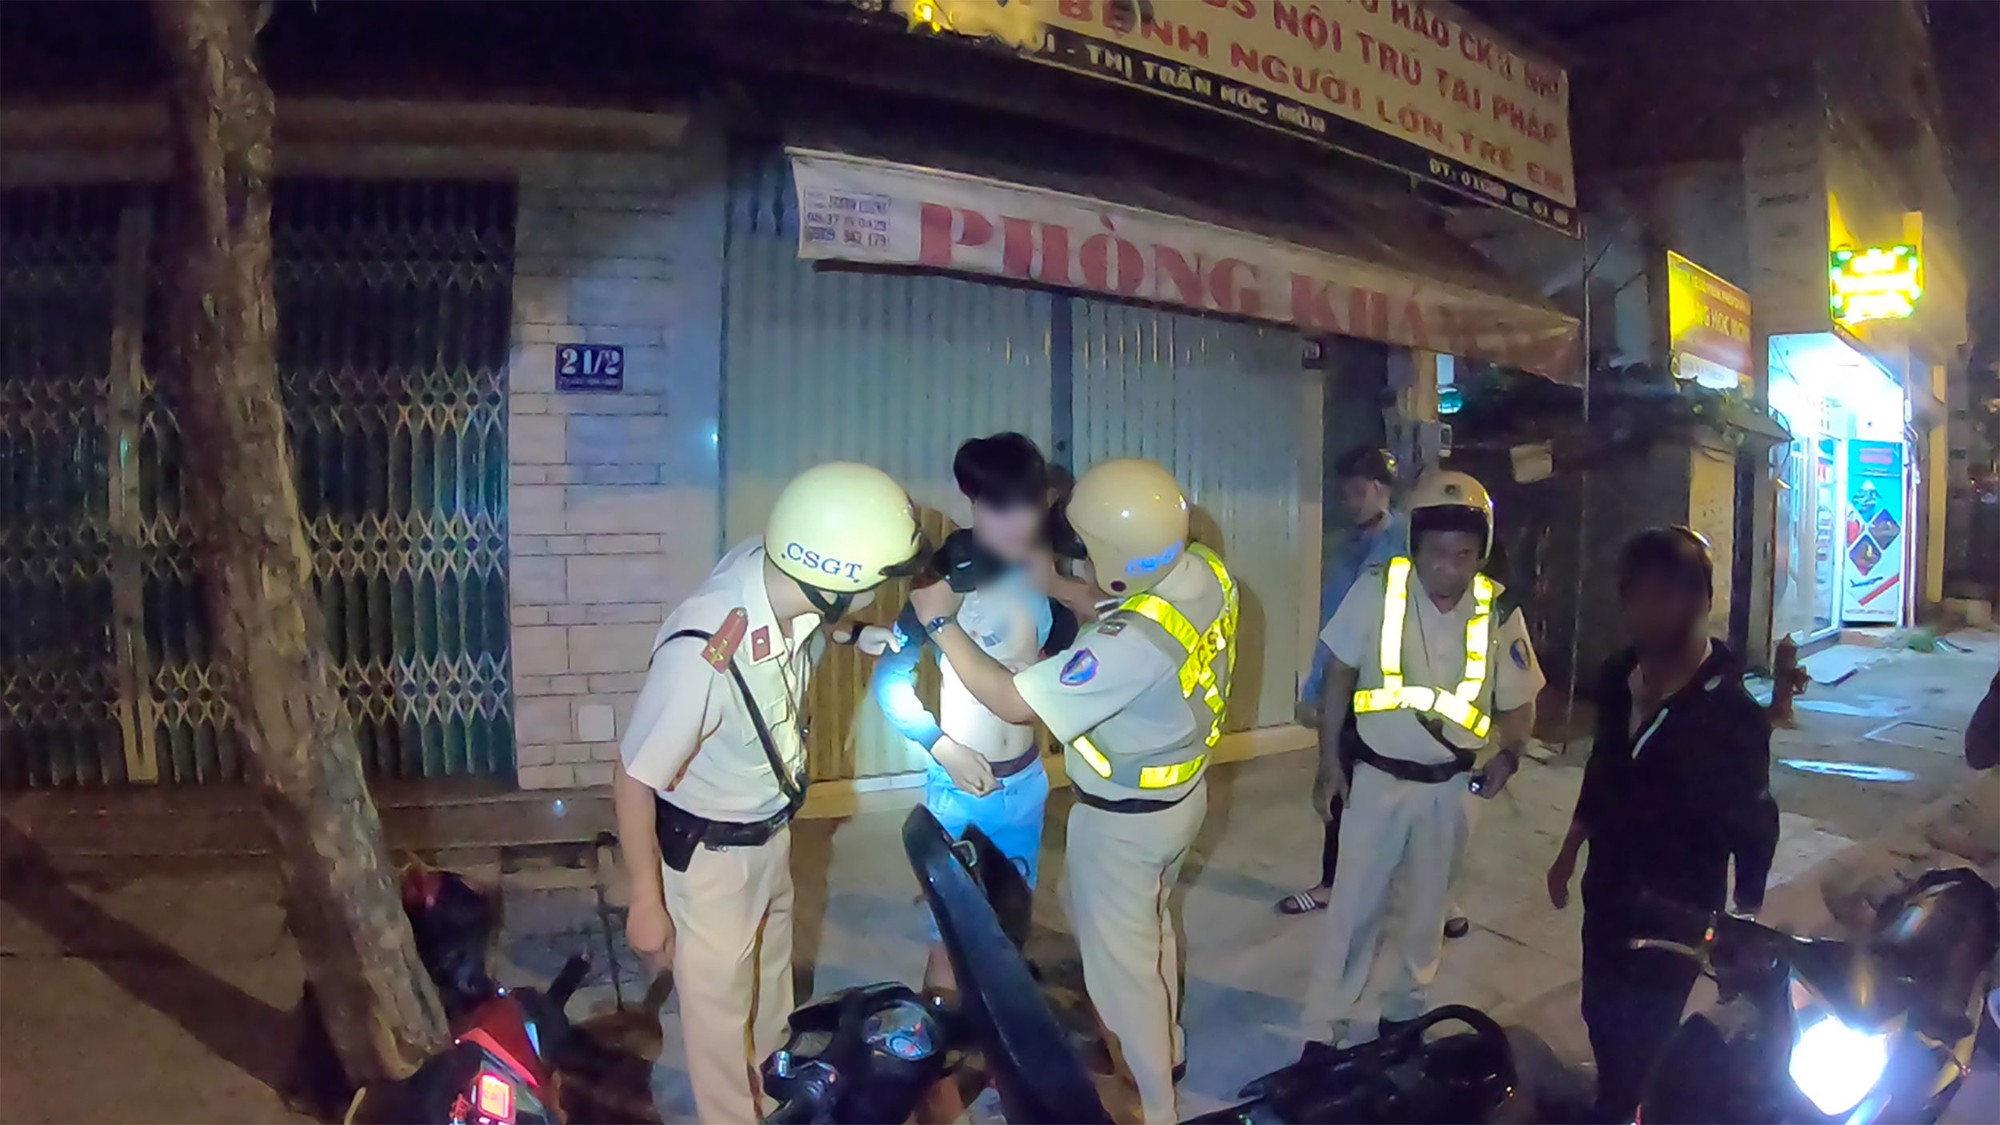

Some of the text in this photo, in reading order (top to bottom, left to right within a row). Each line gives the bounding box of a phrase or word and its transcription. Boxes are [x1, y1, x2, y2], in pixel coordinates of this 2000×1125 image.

[1273, 0, 1342, 53] NỘI
[920, 202, 1262, 315] PHÒNG
[561, 348, 620, 376] 21/2
[787, 542, 862, 579] CSGT
